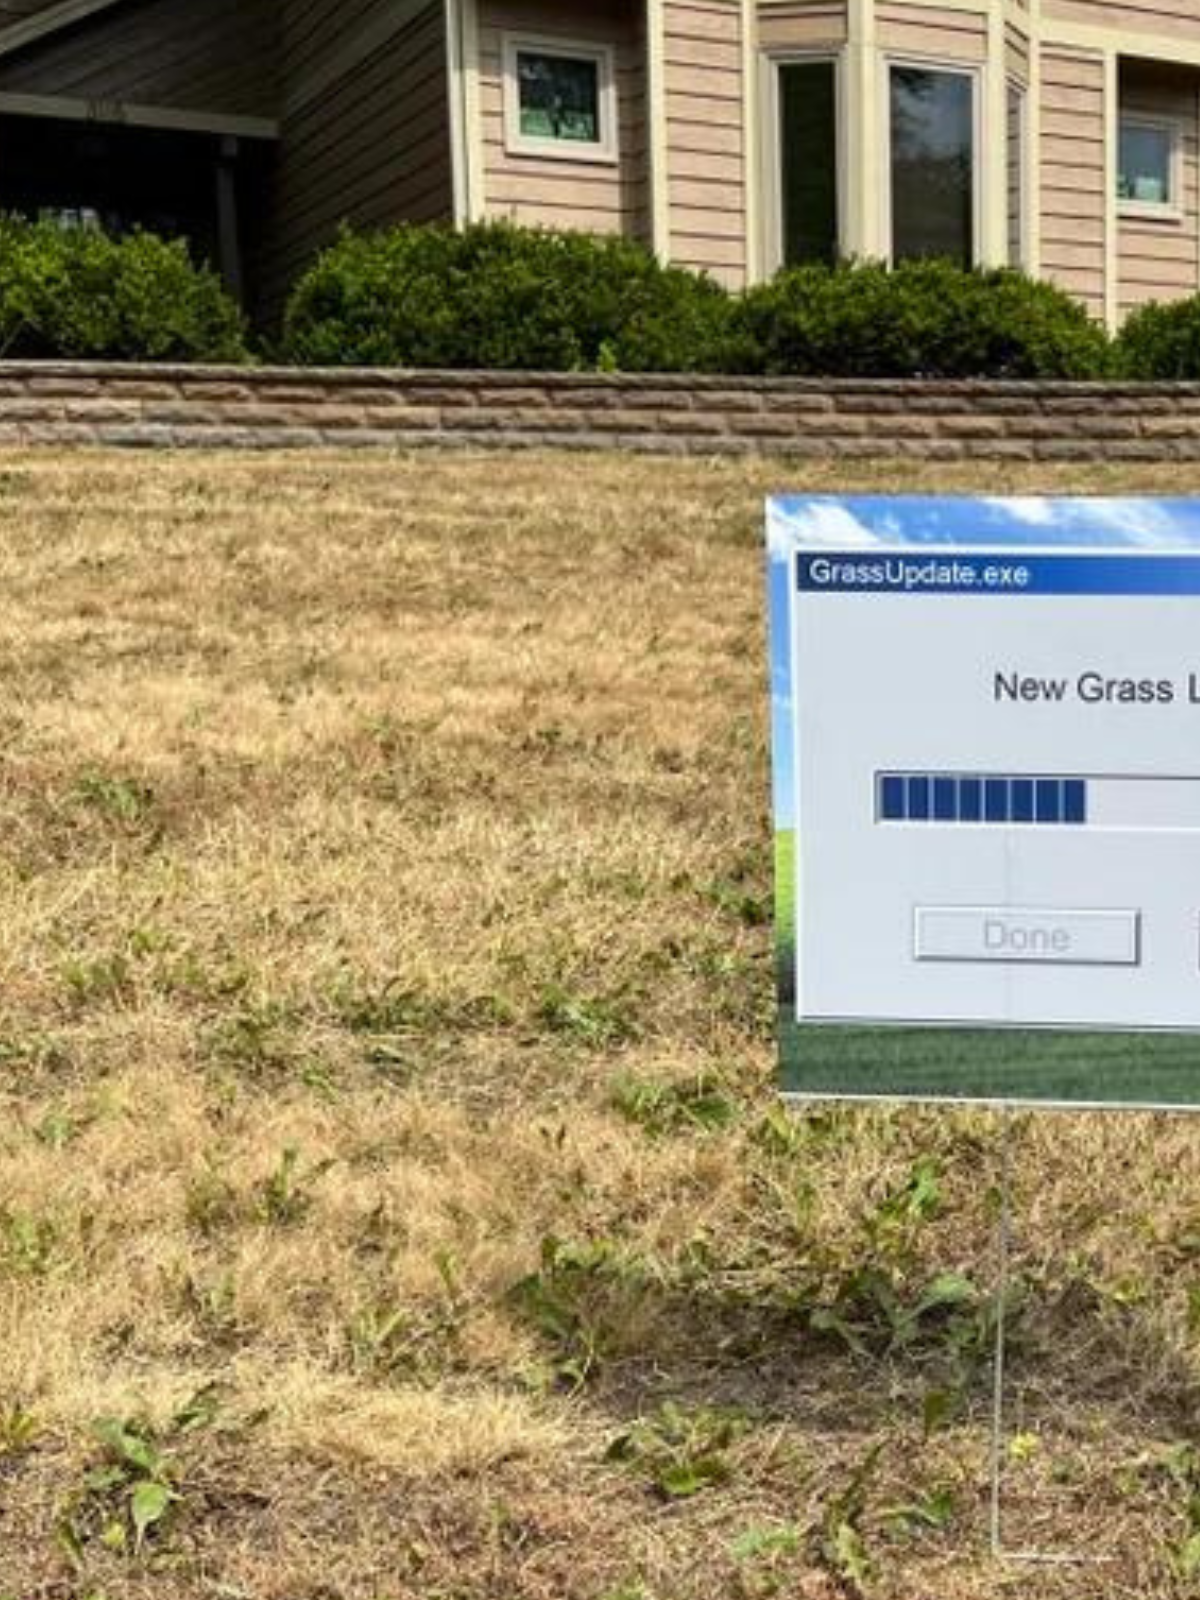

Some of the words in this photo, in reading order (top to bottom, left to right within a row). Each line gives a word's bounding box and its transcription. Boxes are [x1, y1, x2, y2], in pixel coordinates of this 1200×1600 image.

[809, 558, 1029, 589] GrassUpdate.exe
[994, 672, 1068, 701] New
[1076, 671, 1174, 702] Grass
[983, 919, 1071, 953] Done
